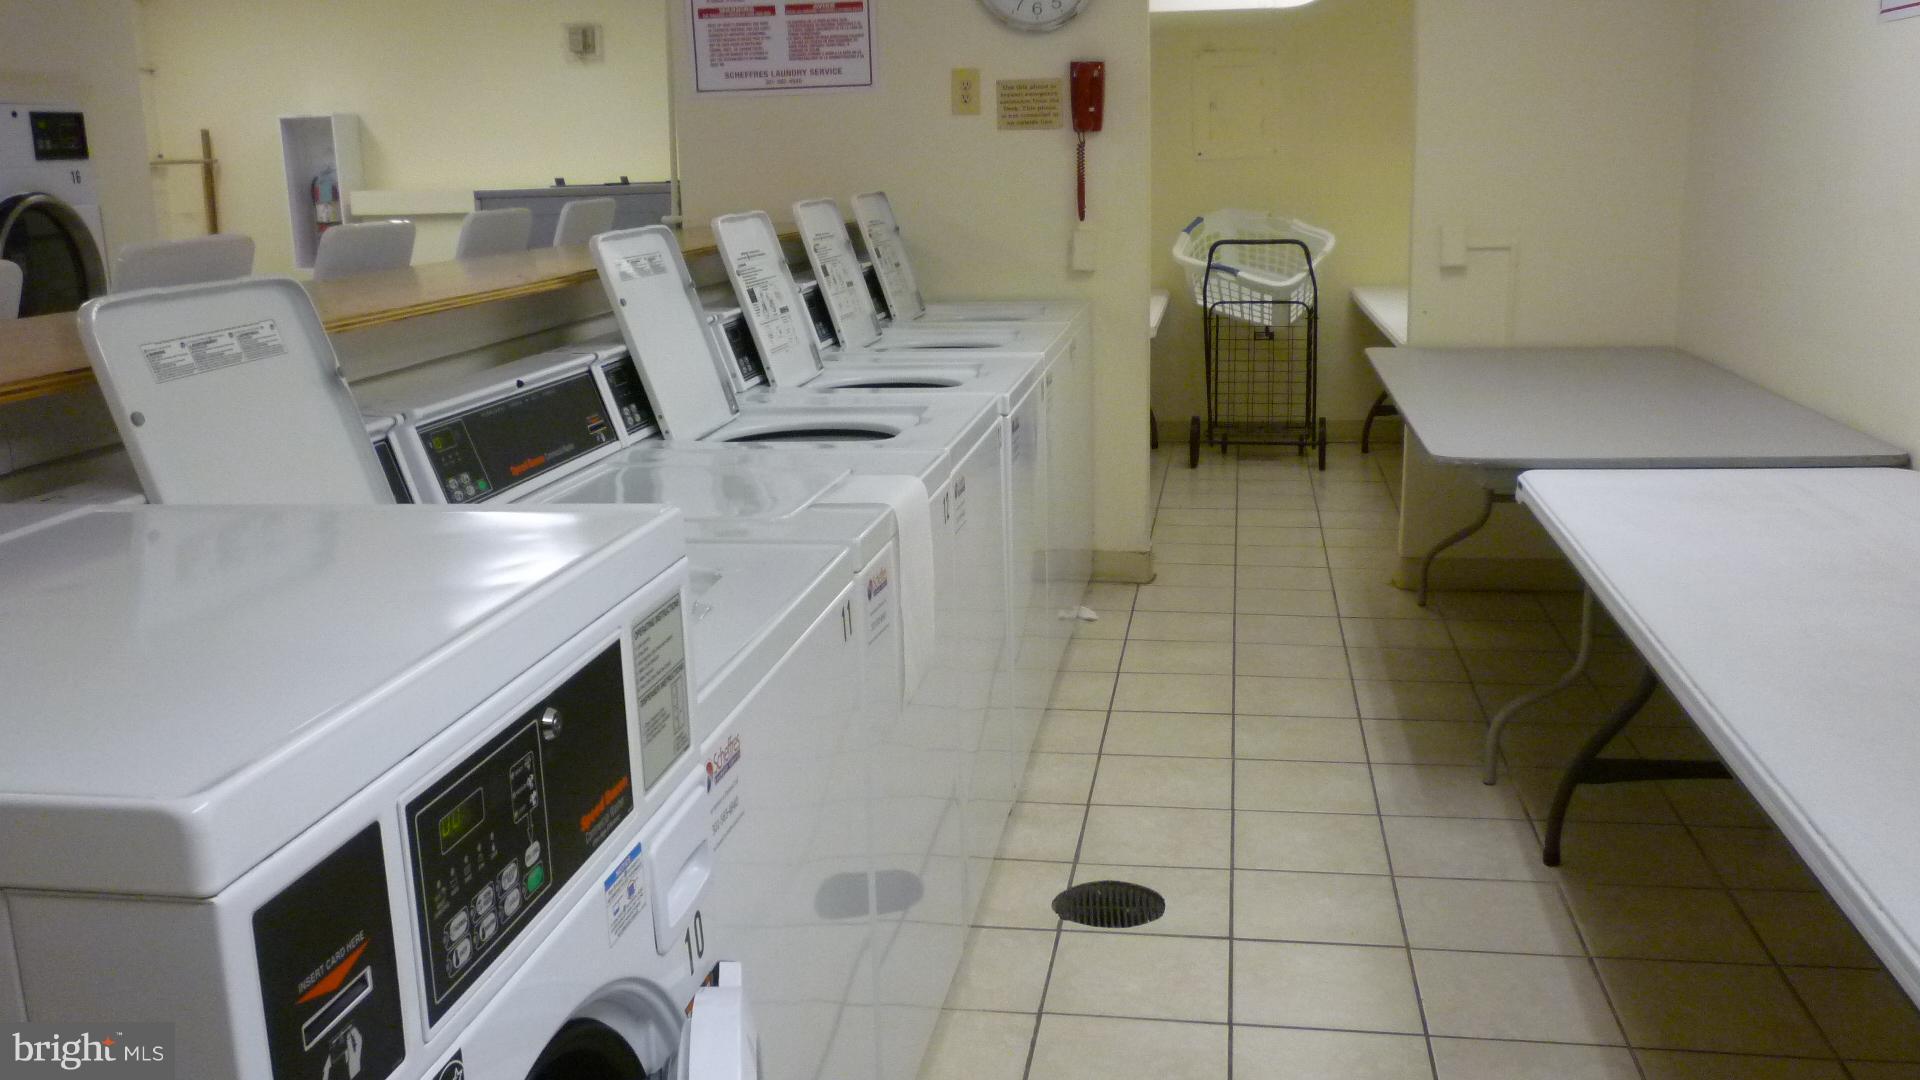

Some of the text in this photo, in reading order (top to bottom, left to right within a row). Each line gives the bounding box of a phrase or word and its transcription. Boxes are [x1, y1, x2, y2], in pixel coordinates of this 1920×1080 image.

[1032, 2, 1043, 15] 6
[771, 69, 807, 78] LAUNDRY
[809, 67, 843, 76] SERVICE
[71, 169, 82, 185] 16
[841, 599, 853, 643] 11
[684, 909, 705, 977] 10
[298, 929, 365, 993] INSERT CARD HERE
